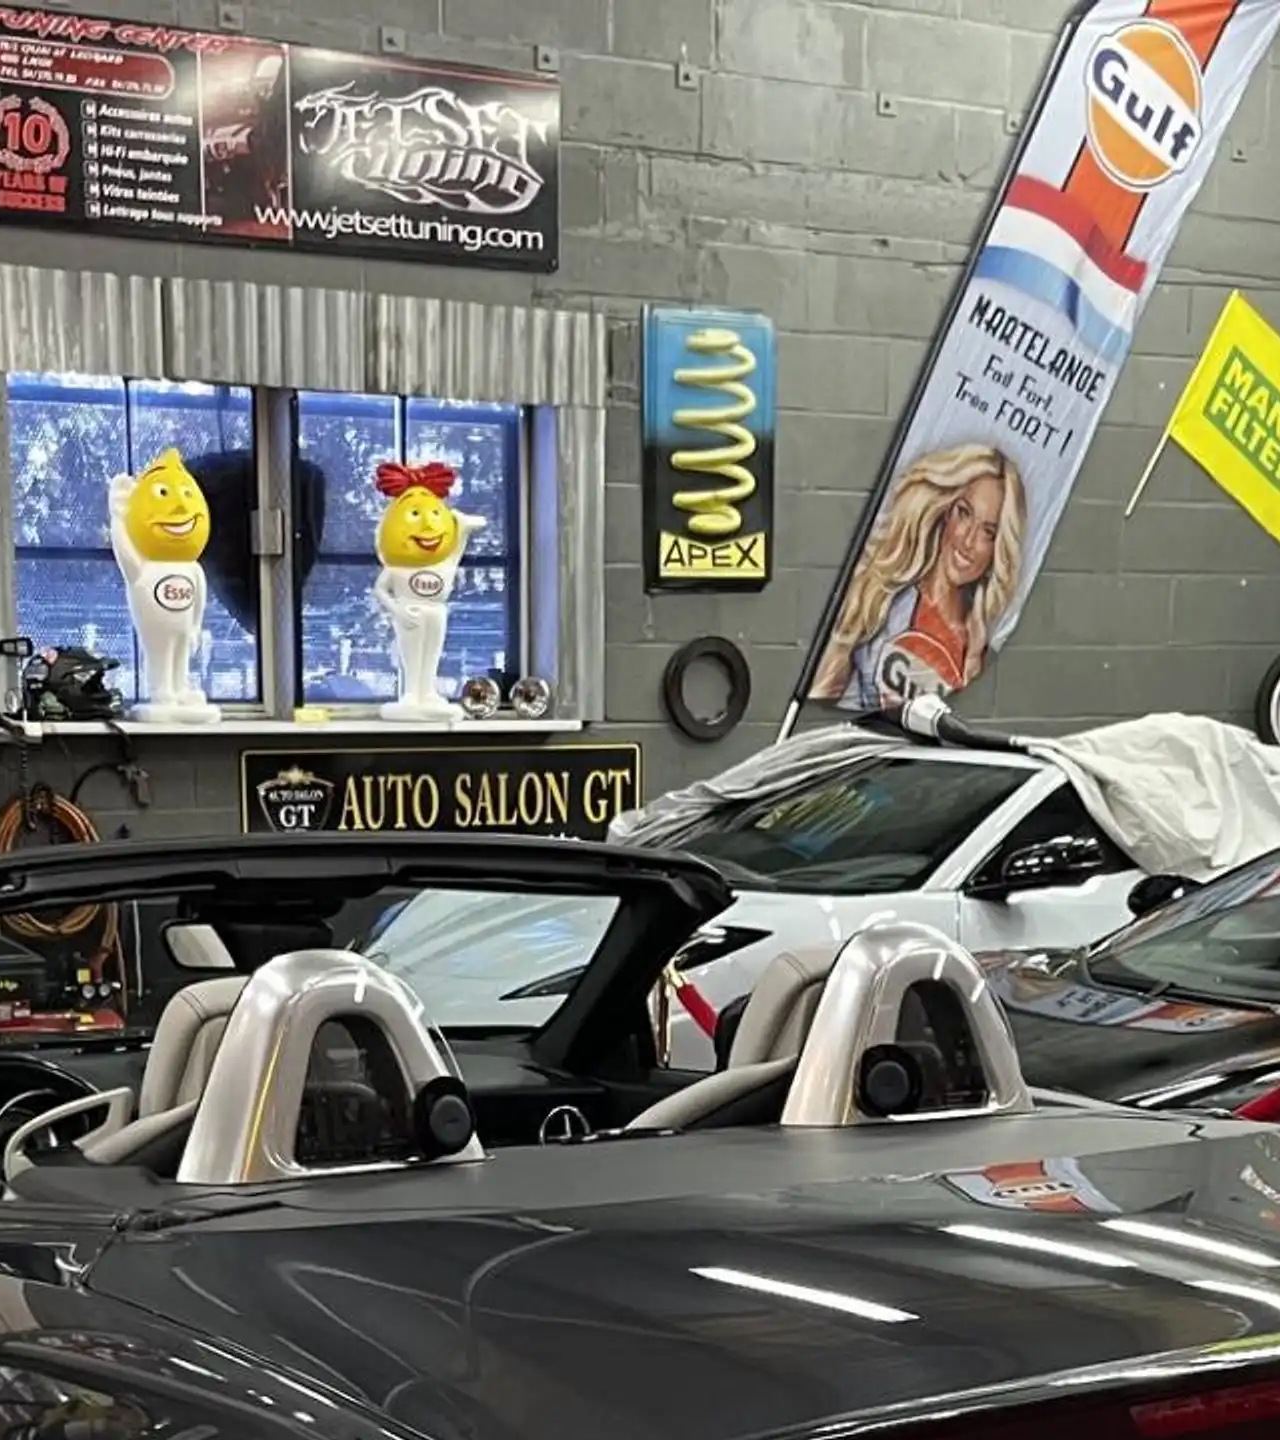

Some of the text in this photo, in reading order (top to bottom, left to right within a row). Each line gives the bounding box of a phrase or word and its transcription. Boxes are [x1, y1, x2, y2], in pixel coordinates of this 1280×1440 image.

[99, 103, 161, 122] Accessoires
[1093, 48, 1195, 161] Gulf
[3, 111, 52, 153] 10
[100, 125, 121, 138] Kits
[255, 204, 543, 251] www.jetsettuning.com
[664, 537, 759, 568] APEX
[164, 584, 194, 601] Esso
[338, 768, 631, 830] AUTO SALON GT
[280, 804, 316, 828] GT
